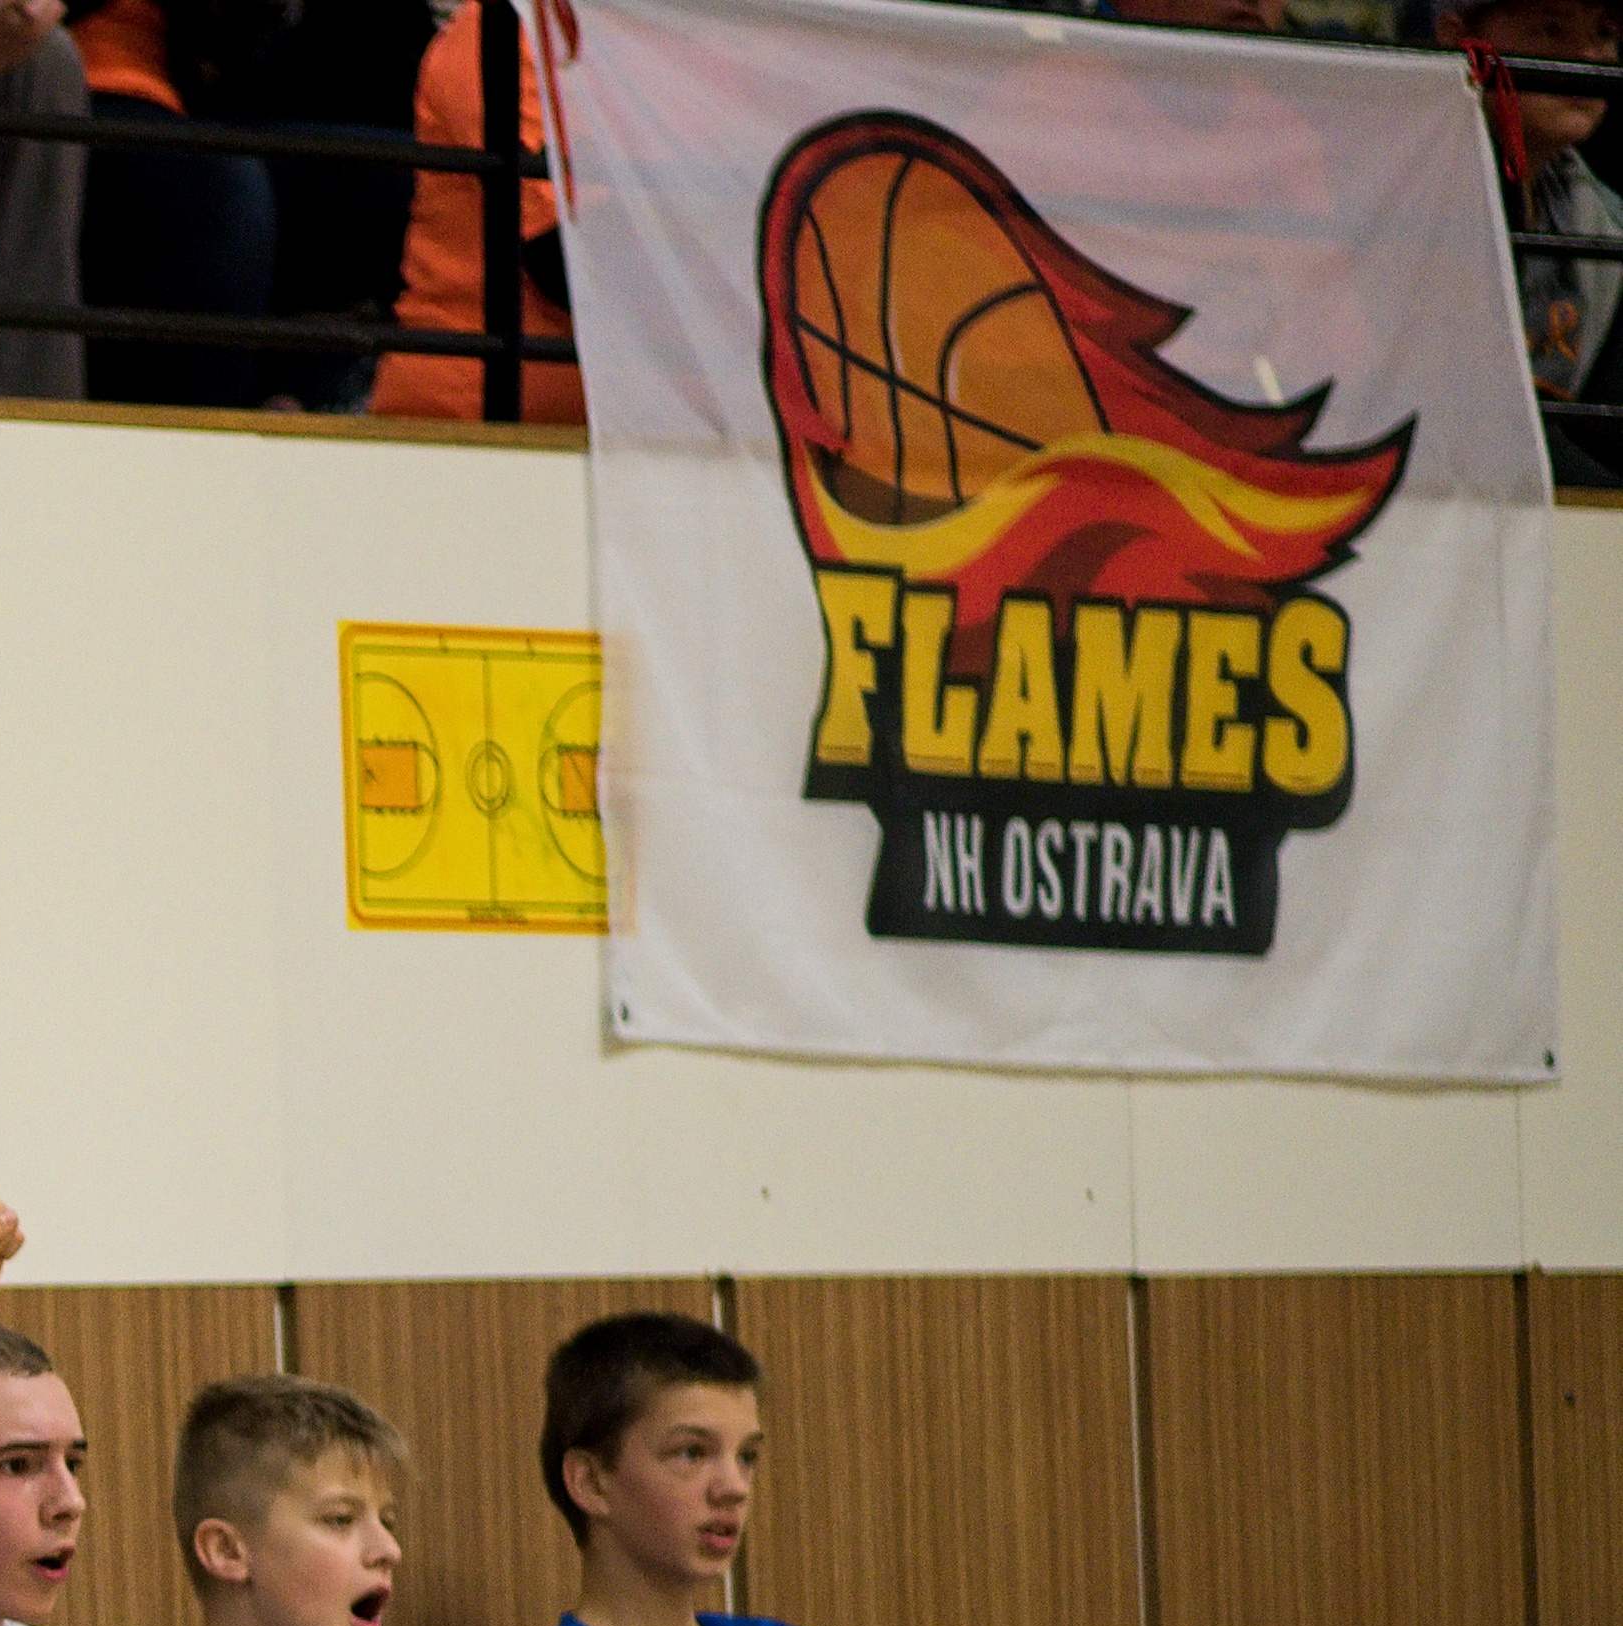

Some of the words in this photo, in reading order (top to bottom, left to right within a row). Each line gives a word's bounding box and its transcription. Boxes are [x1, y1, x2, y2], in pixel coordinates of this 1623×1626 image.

[813, 567, 1351, 796] FLAMES
[921, 809, 986, 915] NH
[999, 814, 1238, 927] OSTRAVA
